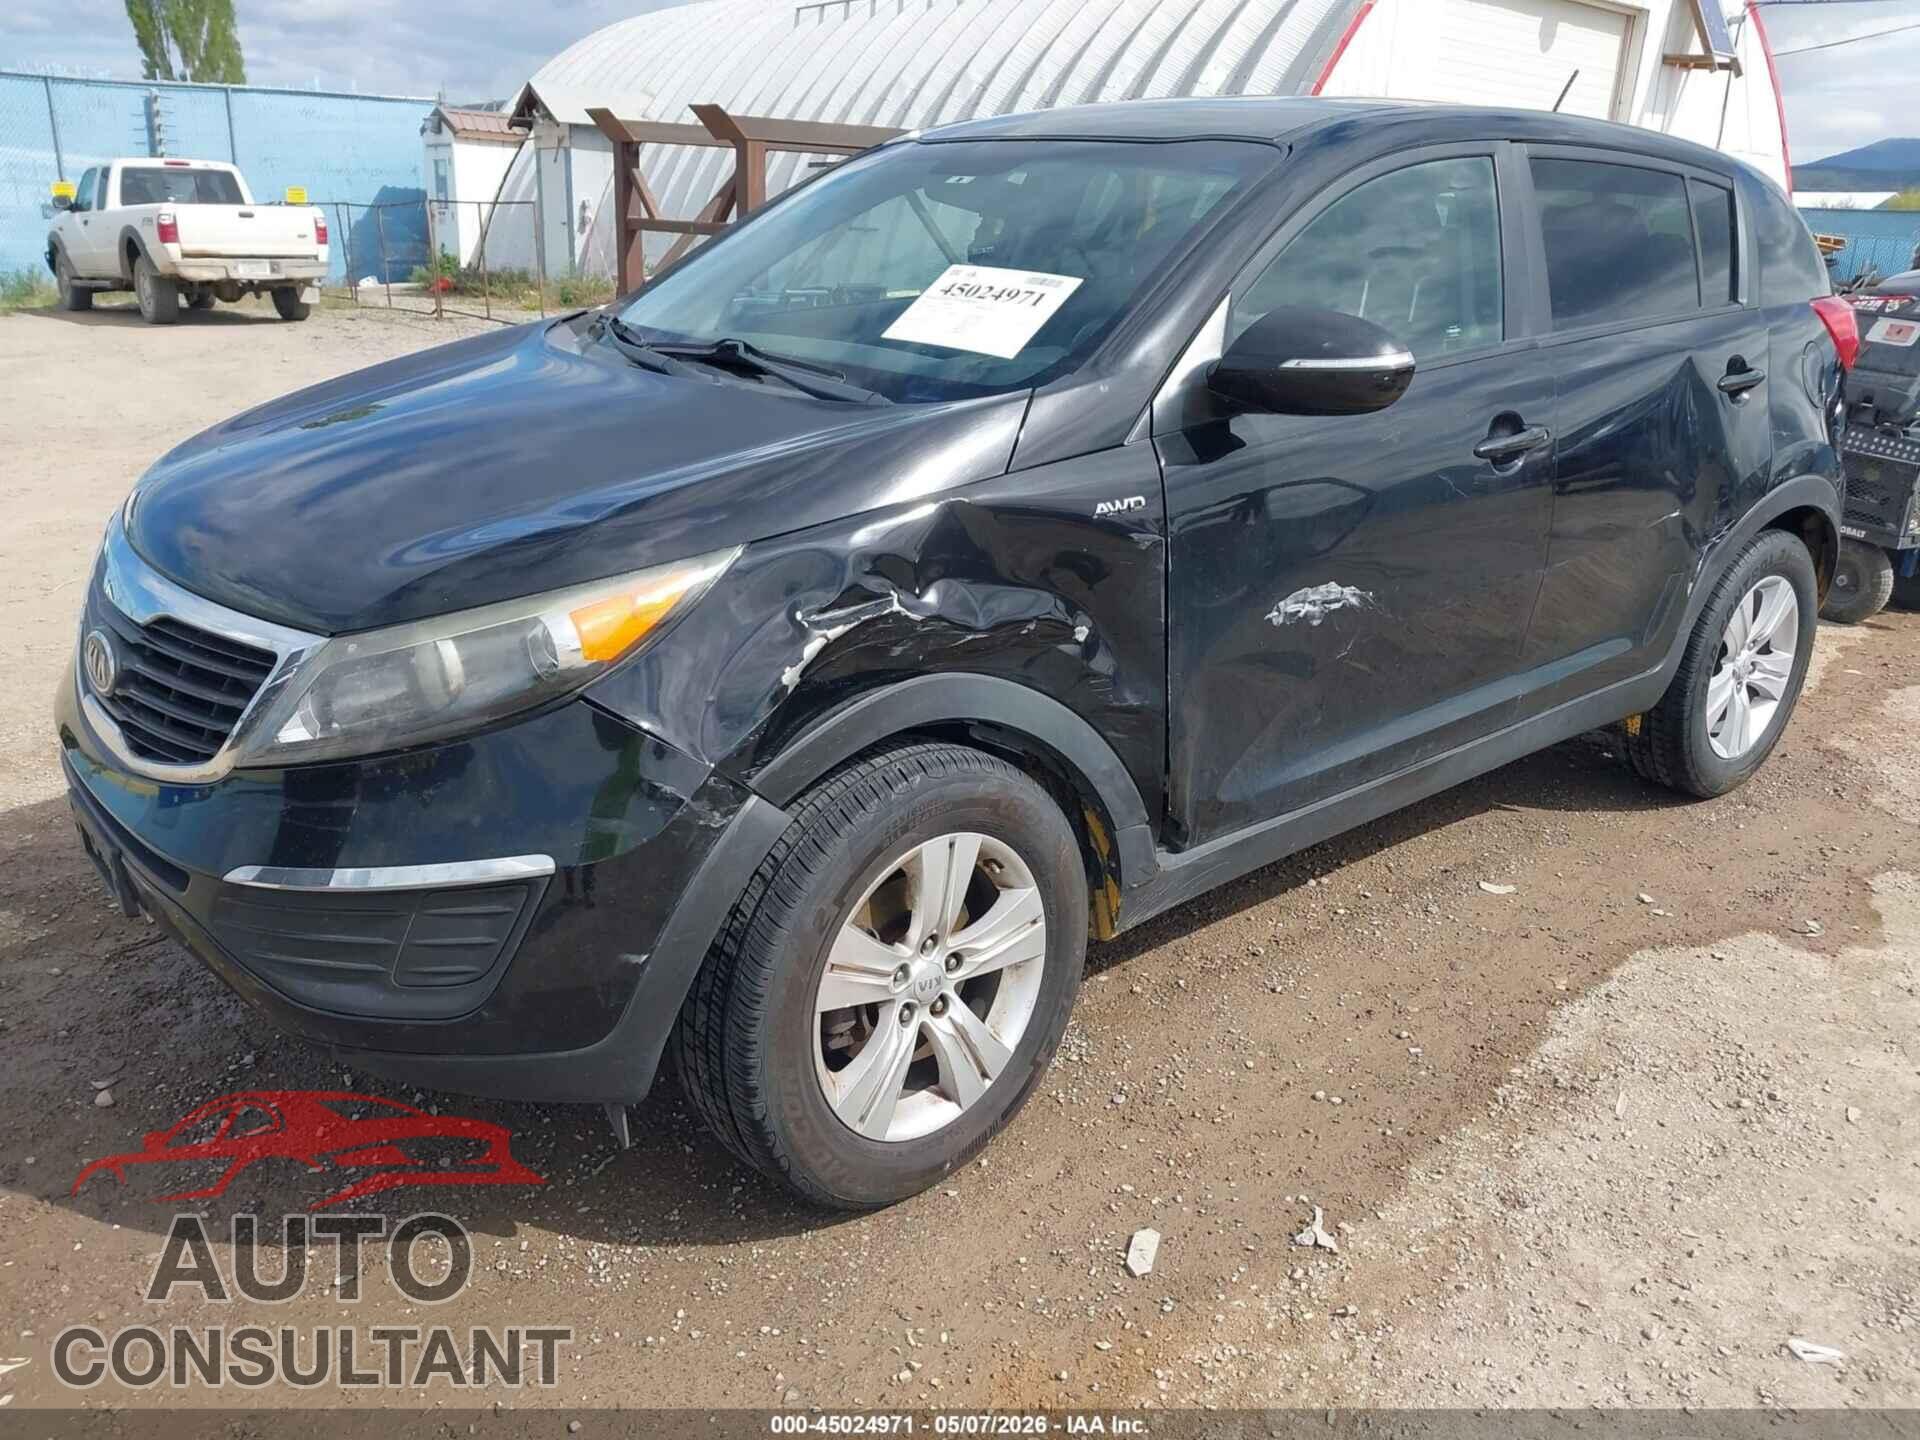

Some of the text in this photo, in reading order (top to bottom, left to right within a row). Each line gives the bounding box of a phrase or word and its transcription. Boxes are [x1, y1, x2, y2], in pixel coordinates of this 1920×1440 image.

[940, 282, 1046, 307] 45024971
[1095, 495, 1146, 515] AWD
[1839, 525, 1866, 538] OBALT
[918, 975, 942, 993] KIA
